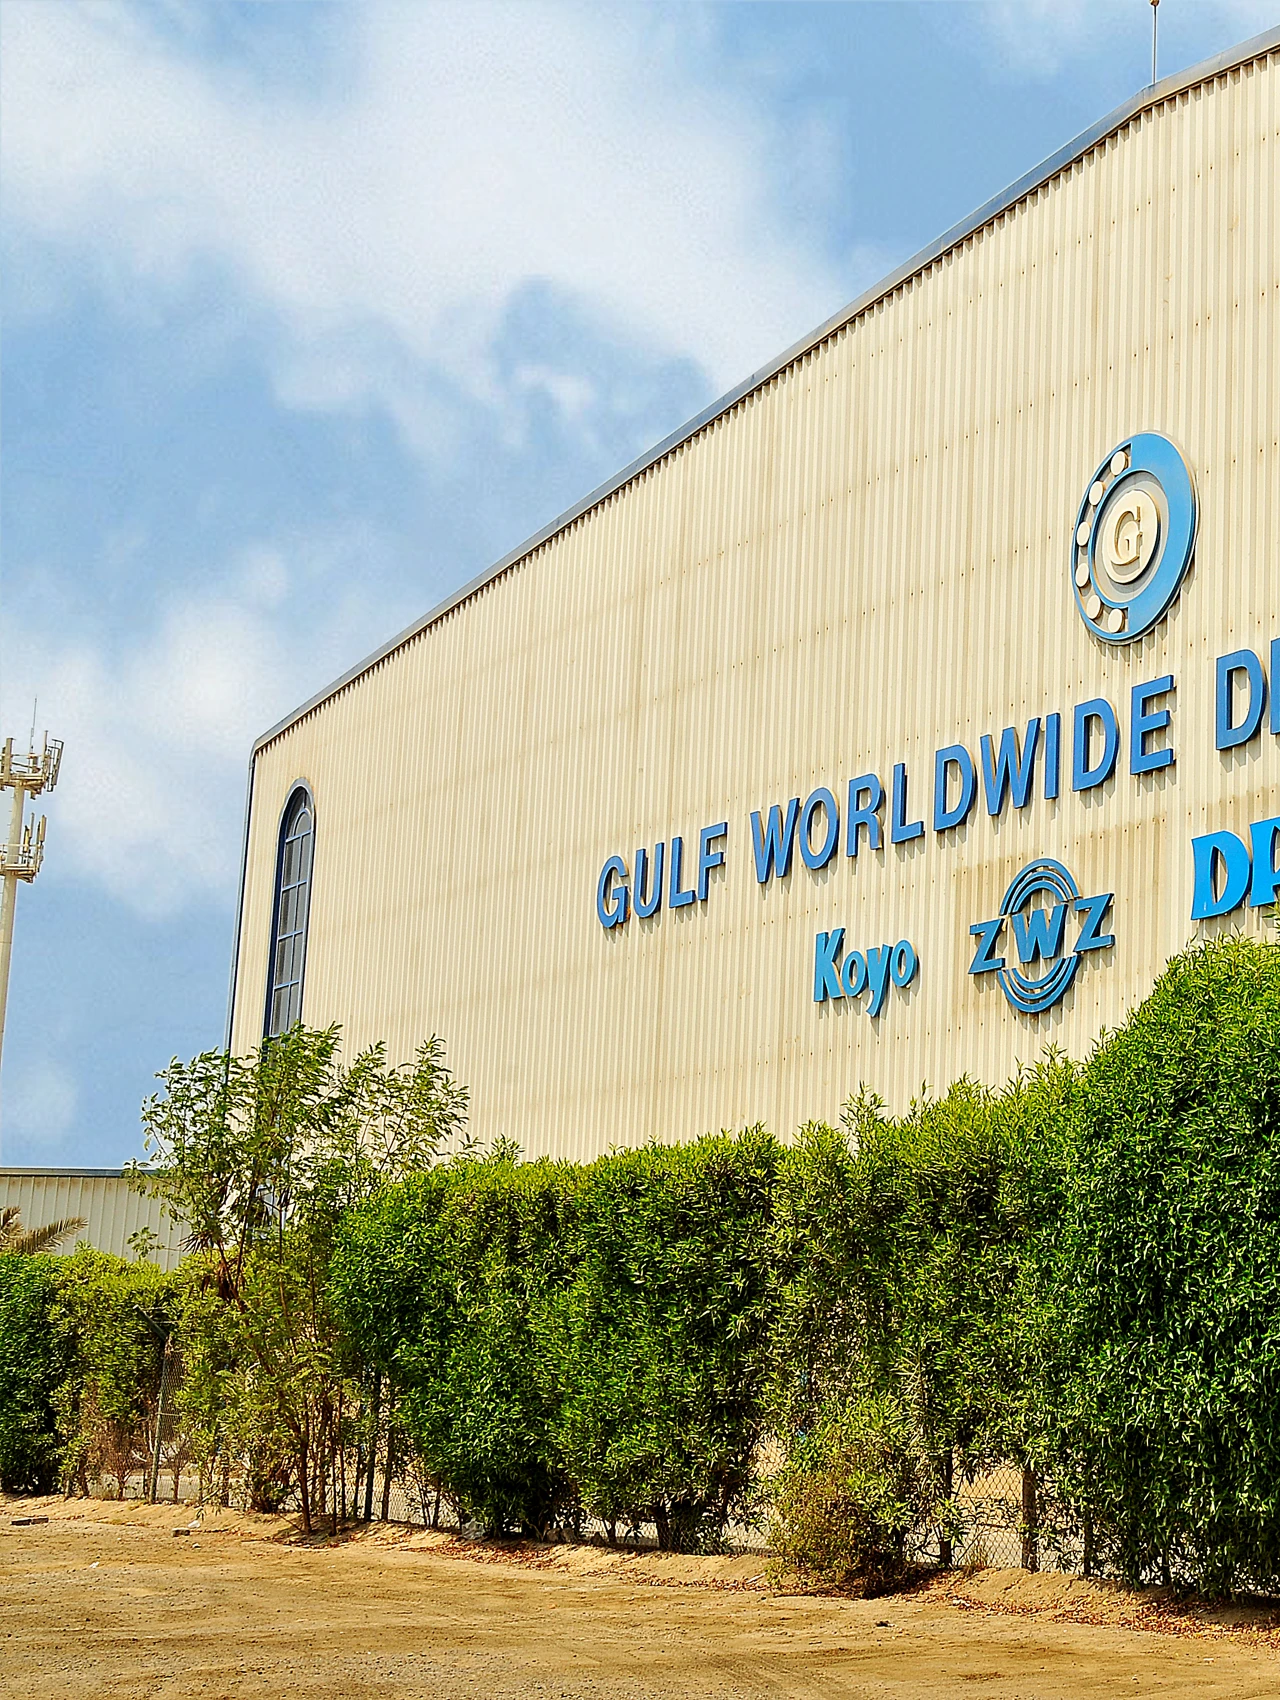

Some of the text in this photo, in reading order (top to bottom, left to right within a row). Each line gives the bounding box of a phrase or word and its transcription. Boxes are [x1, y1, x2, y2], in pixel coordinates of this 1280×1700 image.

[596, 822, 728, 929] GULF
[750, 675, 1175, 884] WORLDWIDE
[813, 927, 918, 1018] Koyo
[968, 893, 1116, 975] ZWZ
